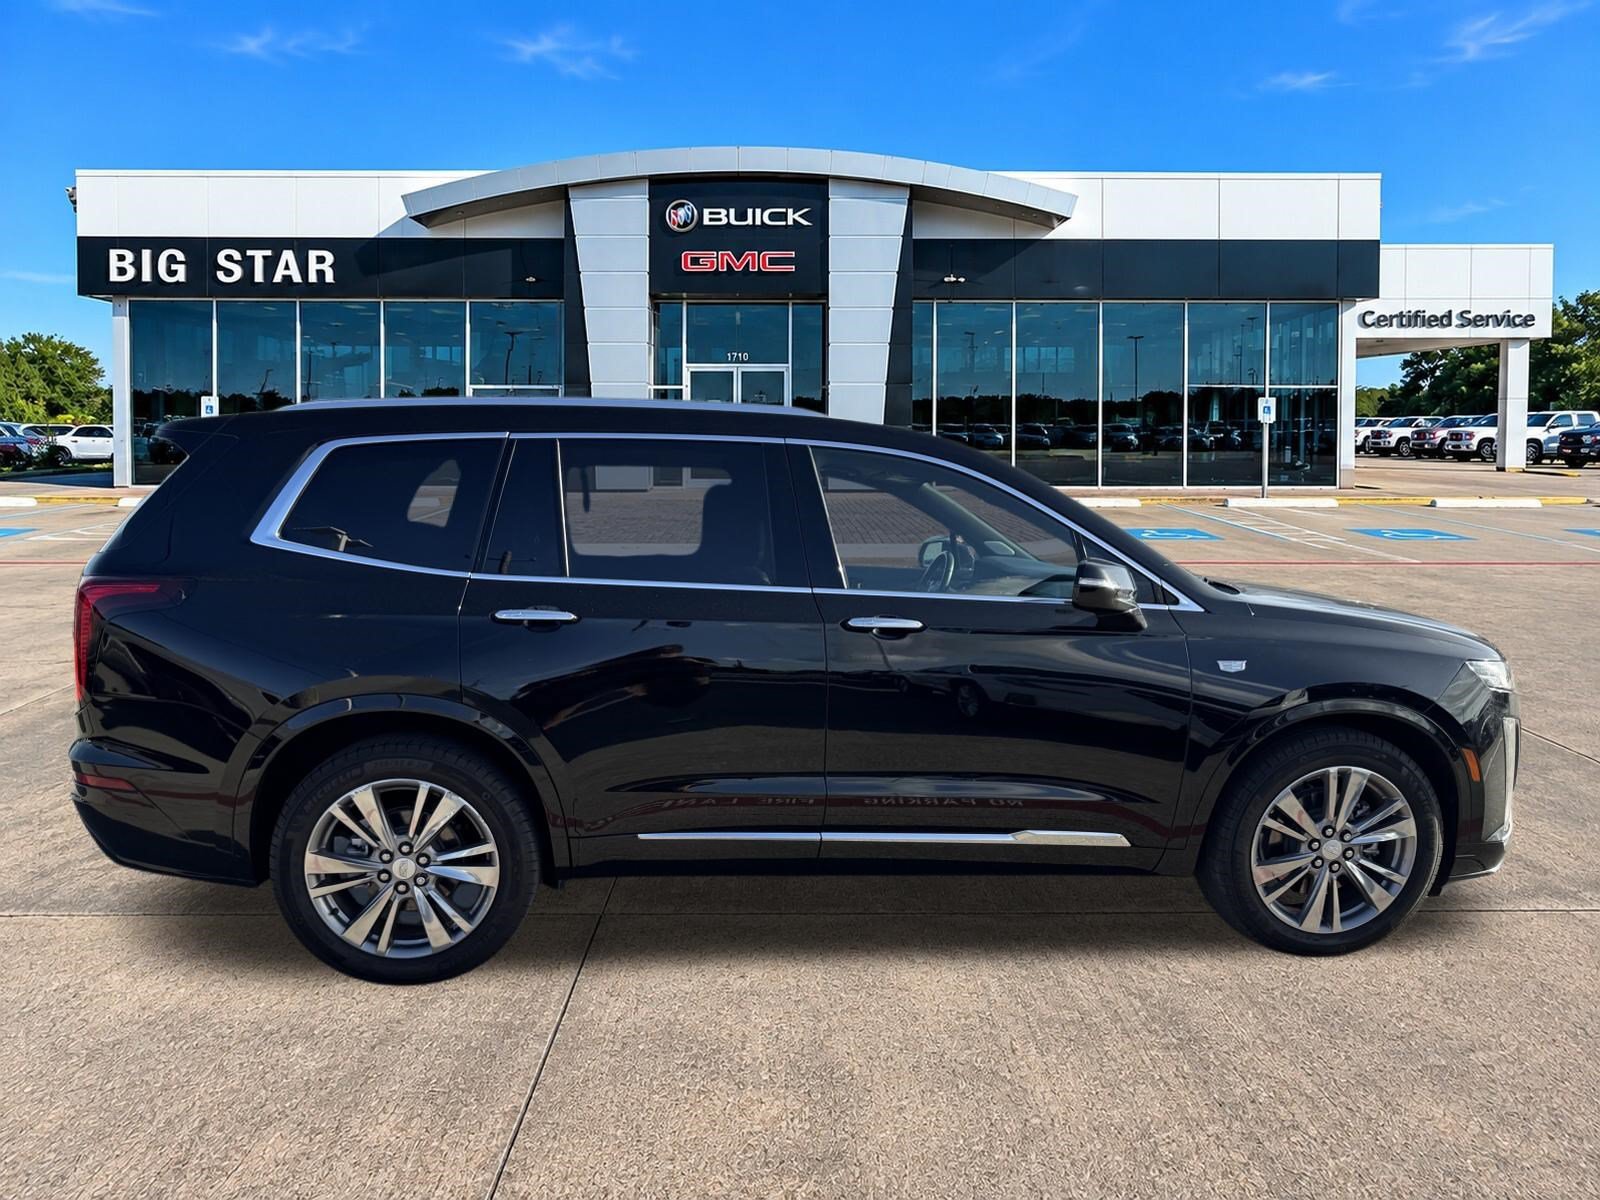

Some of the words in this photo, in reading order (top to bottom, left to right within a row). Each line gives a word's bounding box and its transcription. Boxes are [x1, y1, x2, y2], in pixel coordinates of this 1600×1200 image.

[703, 208, 813, 226] BUICK
[109, 249, 186, 283] BIG
[216, 248, 336, 284] STAR
[681, 250, 796, 272] GMC
[1359, 309, 1452, 328] Certified
[1455, 309, 1536, 328] Service
[727, 352, 749, 361] 1710
